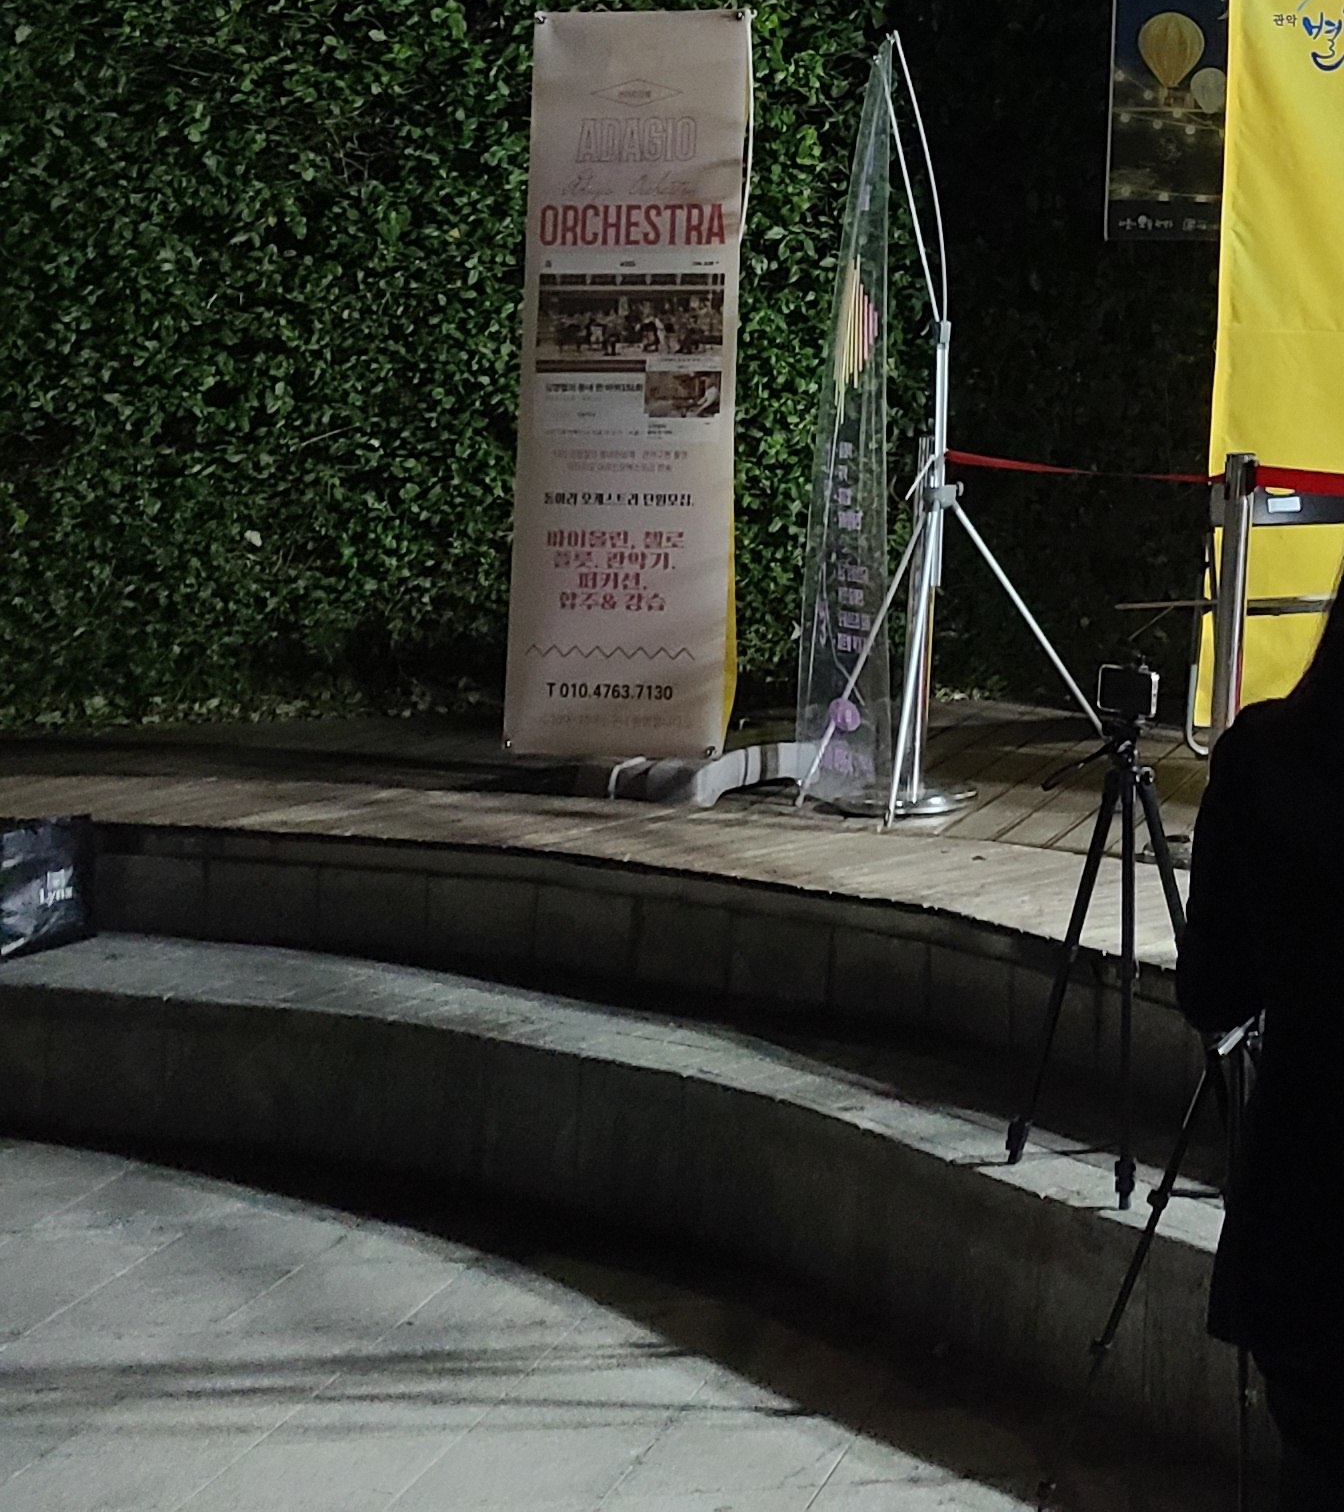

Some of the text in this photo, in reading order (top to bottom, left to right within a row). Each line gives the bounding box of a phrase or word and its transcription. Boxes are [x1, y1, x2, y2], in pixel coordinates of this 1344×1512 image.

[1273, 14, 1298, 28] 관악
[575, 116, 698, 163] ADAGIO
[539, 204, 726, 246] ORCHESTRA
[642, 529, 685, 548] 첼로
[625, 592, 666, 612] 강습
[547, 682, 674, 701] T 010.4763.7130
